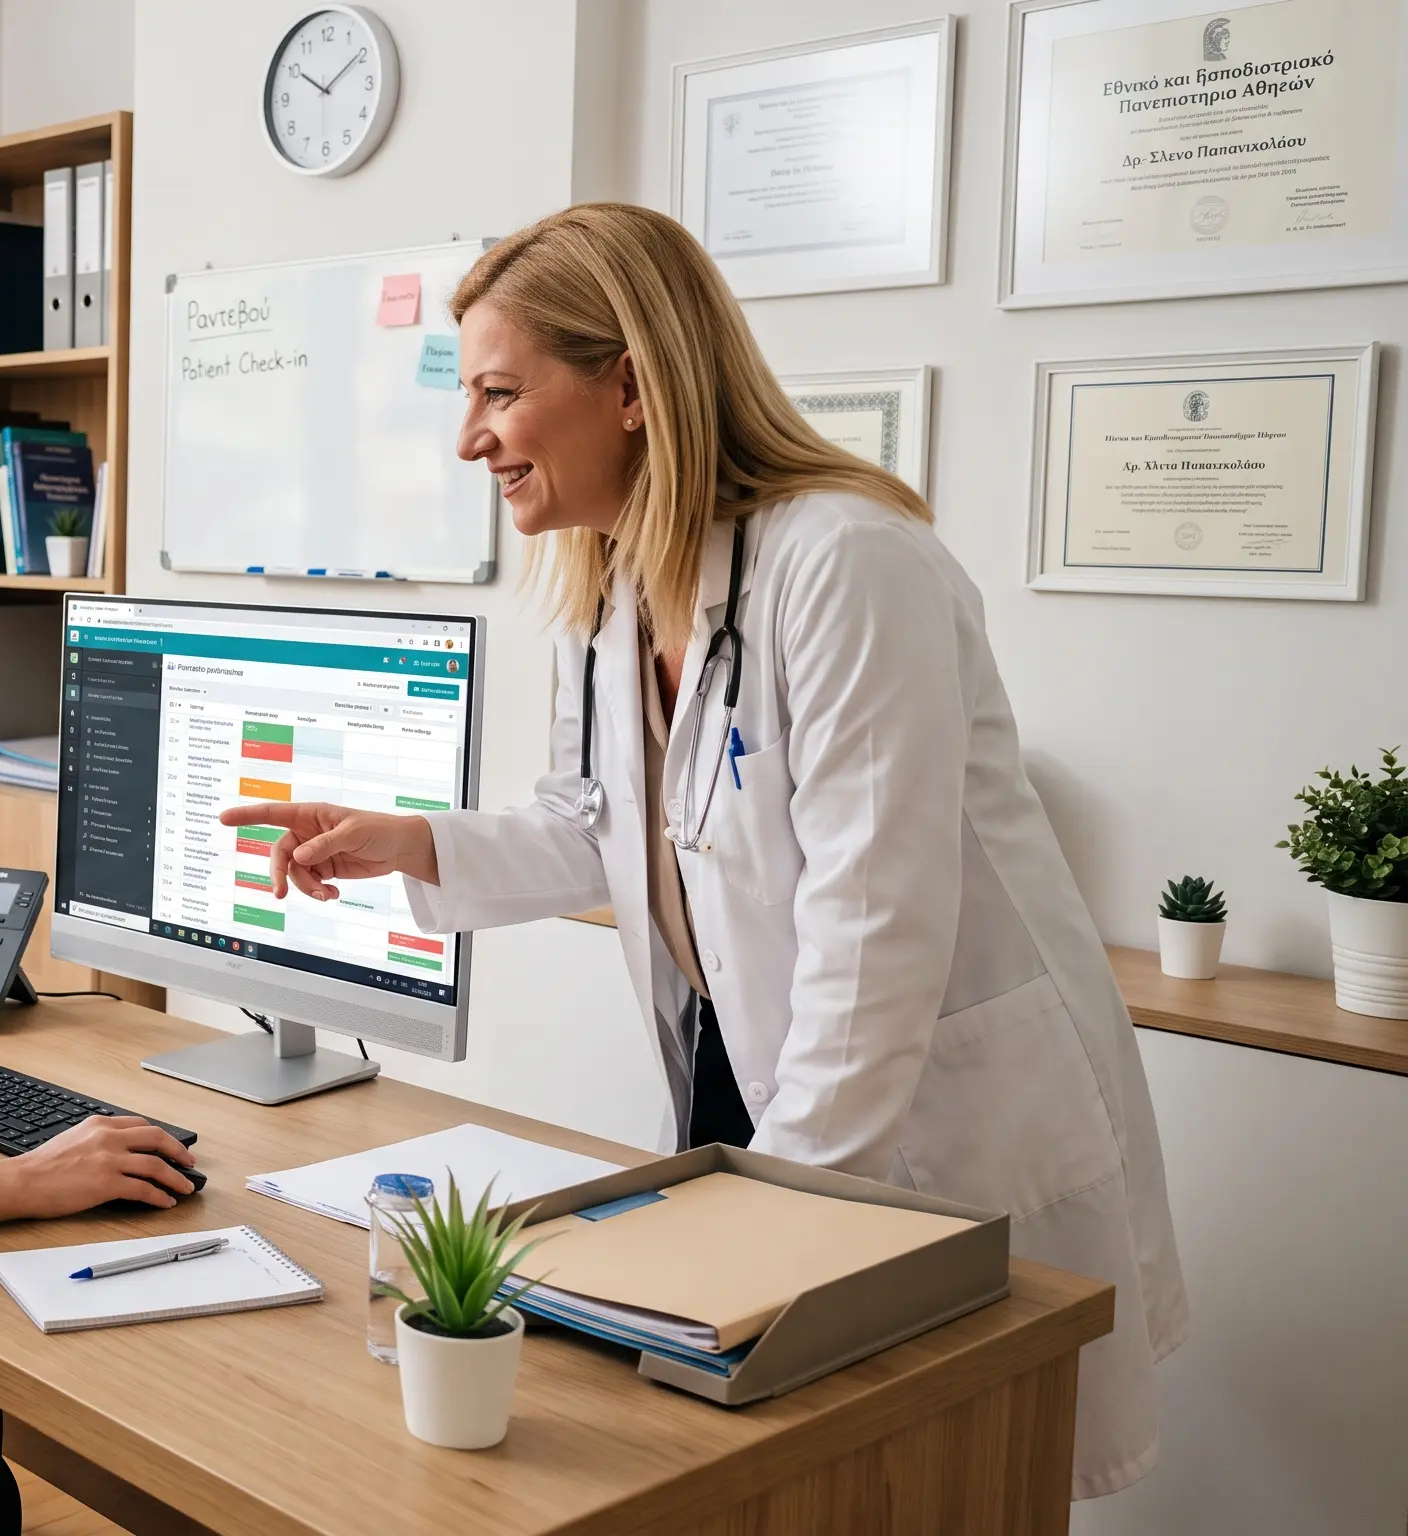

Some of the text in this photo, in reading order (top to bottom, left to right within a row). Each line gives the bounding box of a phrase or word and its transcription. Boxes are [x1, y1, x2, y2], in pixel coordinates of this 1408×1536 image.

[321, 26, 335, 42] 12
[346, 29, 352, 44] 1
[301, 40, 312, 55] 11
[358, 47, 368, 63] 2
[288, 63, 301, 79] 10
[364, 75, 374, 91] 3
[1164, 75, 1190, 88] και
[280, 92, 290, 108] 9
[358, 106, 368, 121] 4
[287, 120, 296, 136] 8
[303, 136, 311, 152] 7
[342, 129, 352, 145] 5
[321, 141, 331, 157] 6
[188, 296, 270, 332] Ραντεβού
[181, 349, 308, 381] Patient Check-in
